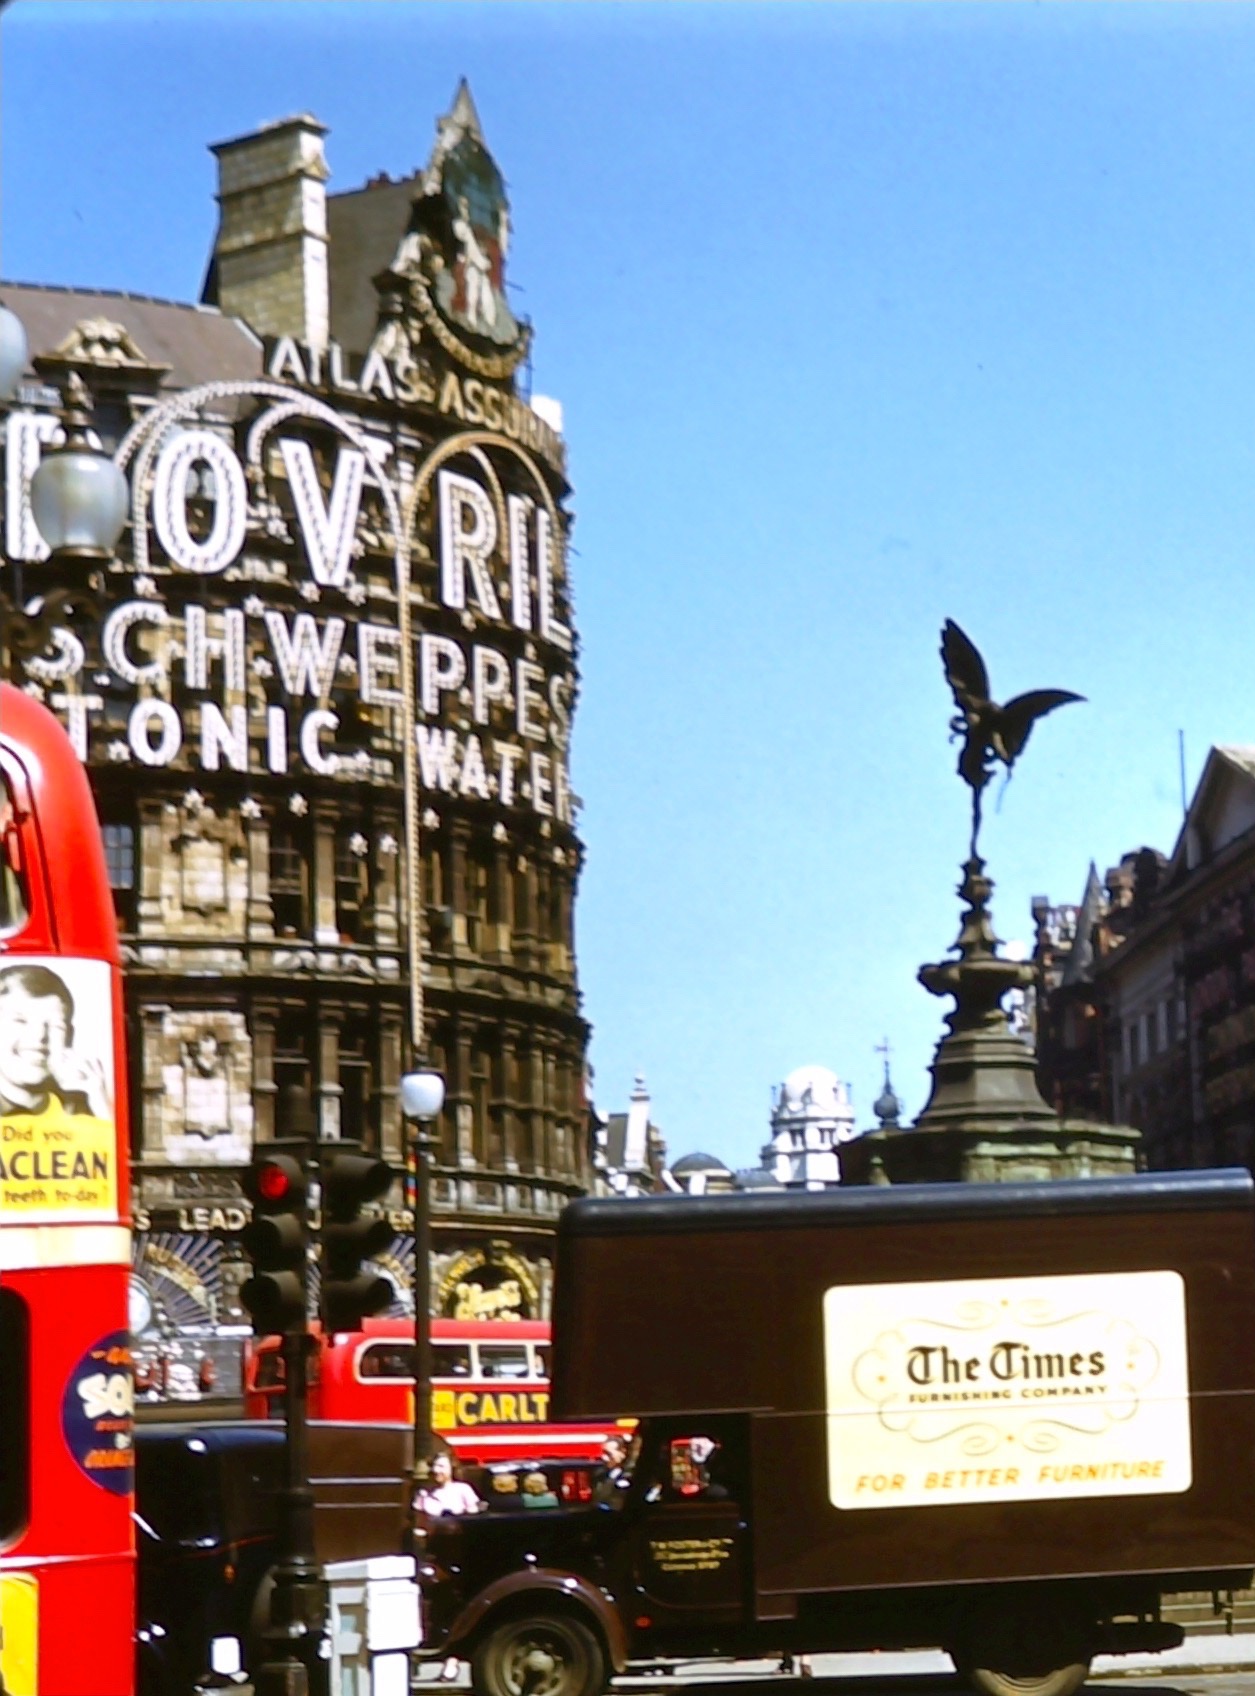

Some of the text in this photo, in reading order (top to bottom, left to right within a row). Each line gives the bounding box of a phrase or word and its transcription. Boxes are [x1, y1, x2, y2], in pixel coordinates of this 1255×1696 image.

[269, 337, 421, 402] ATLAS
[50, 694, 340, 775] TONIC
[2, 1125, 33, 1142] Did
[179, 1207, 251, 1232] LEAD
[907, 1341, 1106, 1385] The Times
[456, 1391, 550, 1425] CARLT
[908, 1385, 1109, 1404] FURNISHING COMPANY
[855, 1460, 1166, 1494] FOR BETTER FURNITURE
